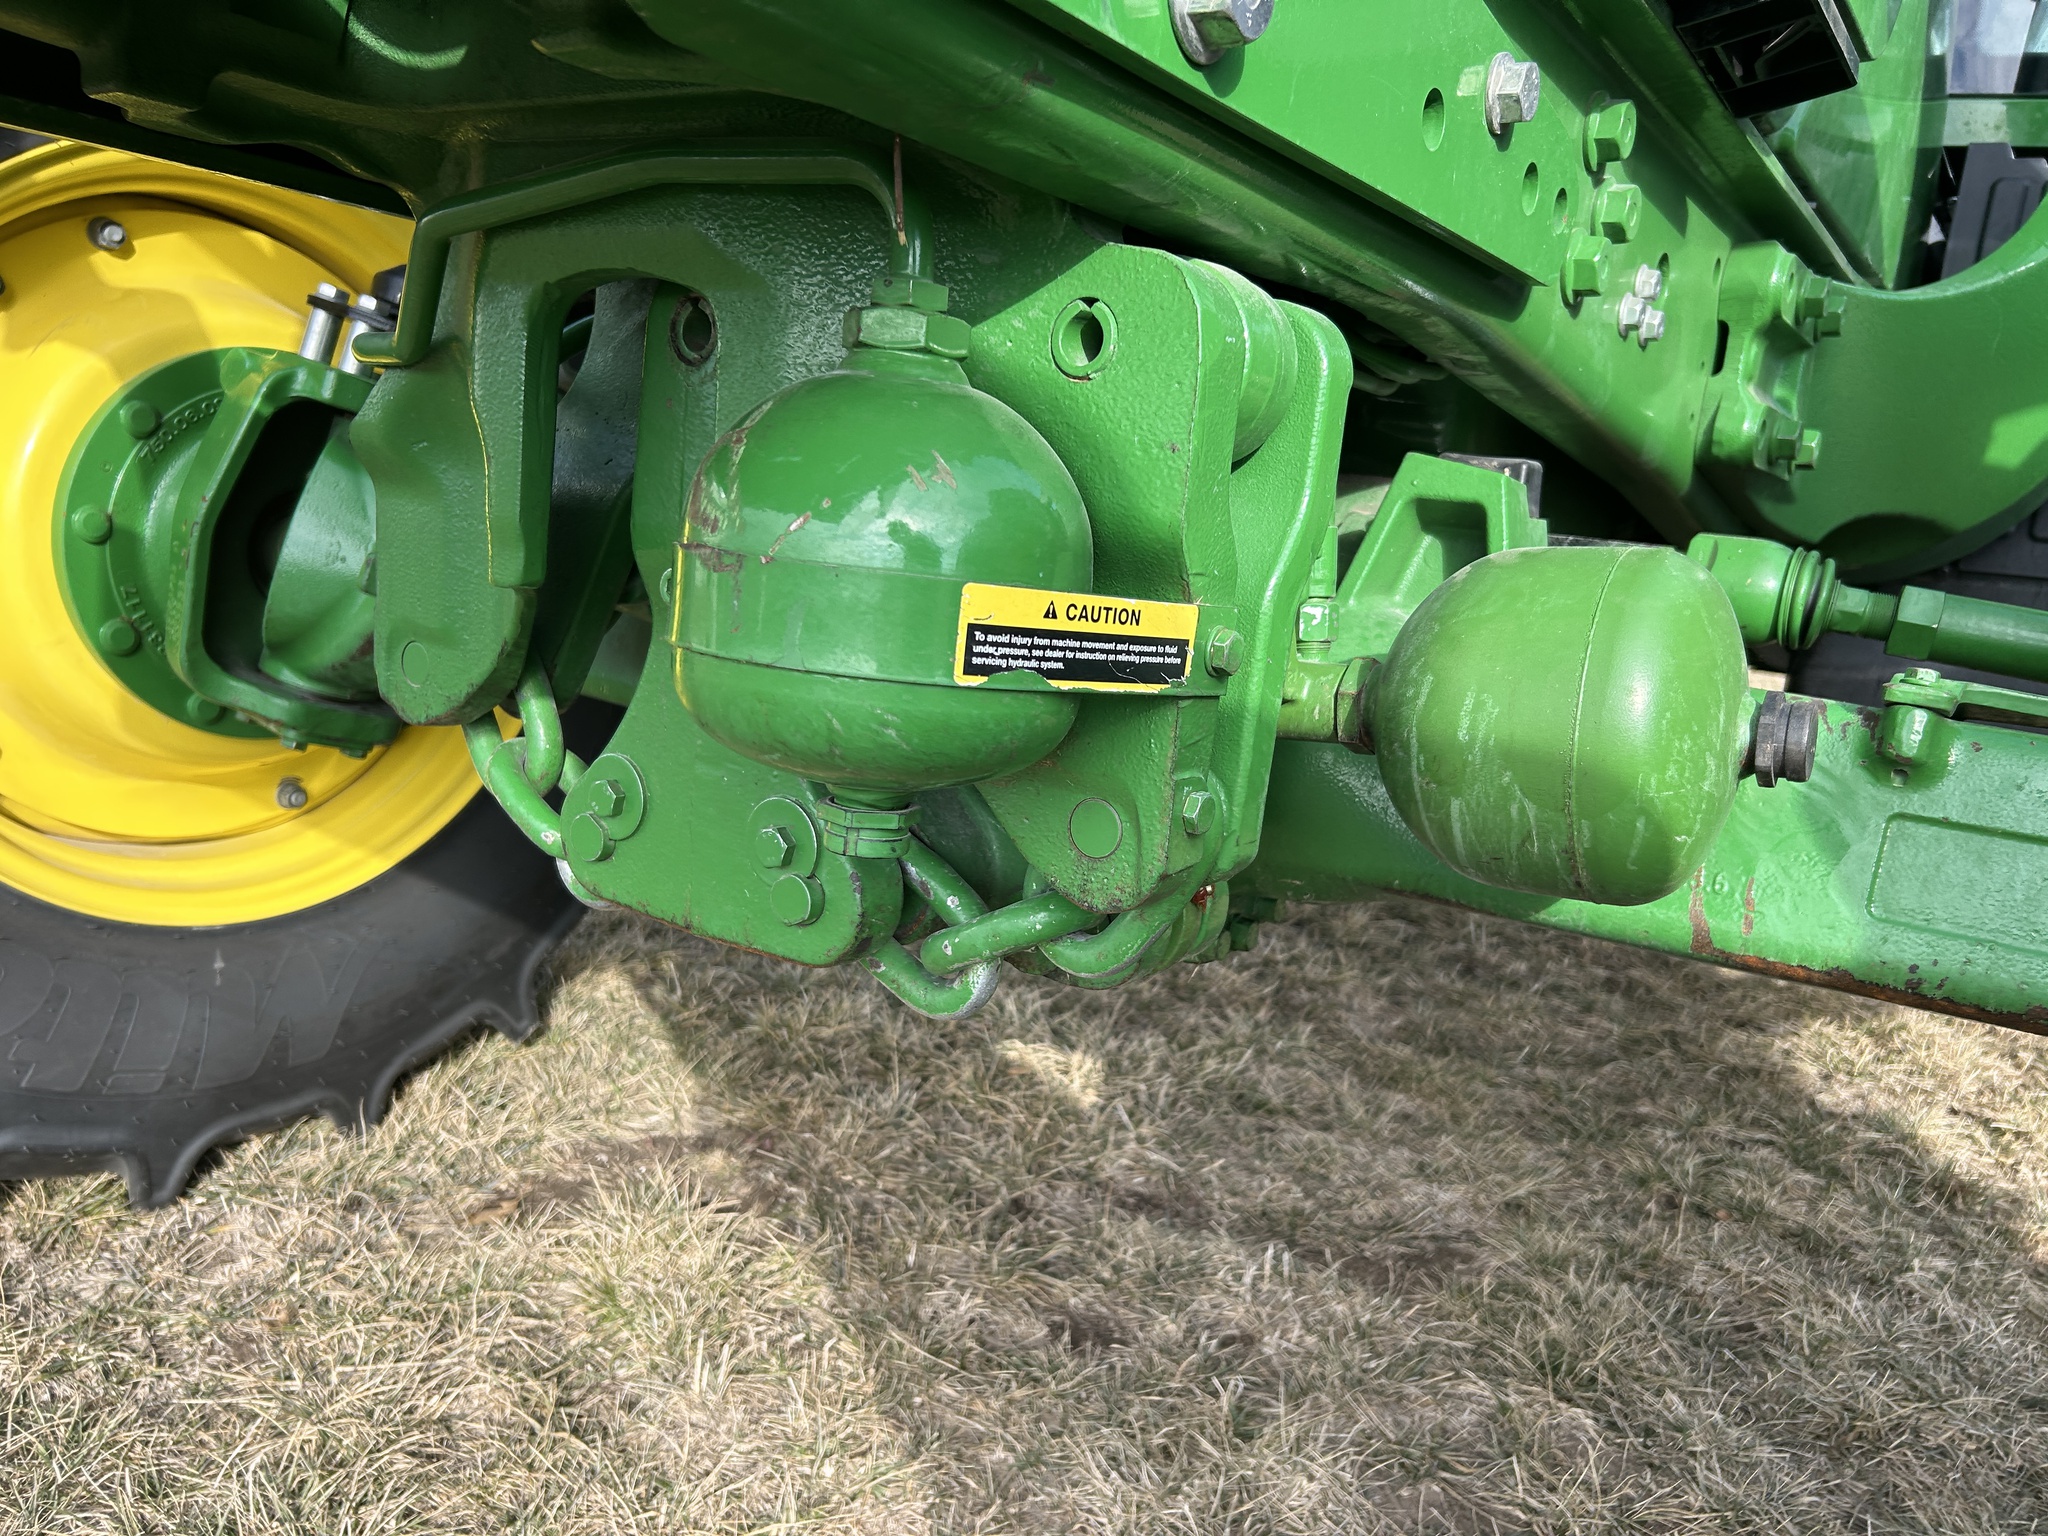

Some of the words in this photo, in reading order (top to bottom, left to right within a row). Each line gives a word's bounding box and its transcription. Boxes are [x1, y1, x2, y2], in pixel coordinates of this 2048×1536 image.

[1066, 603, 1141, 626] CAUTION
[974, 631, 985, 642] To
[986, 633, 1010, 643] avoid
[1011, 634, 1032, 646] injury
[1033, 636, 1051, 646] from
[1051, 638, 1081, 648] machine
[1081, 640, 1116, 650] movement
[1116, 642, 1129, 651] and
[1129, 643, 1157, 653] exposure
[1157, 645, 1164, 653] to
[1164, 645, 1178, 654] fluid
[971, 656, 1008, 668] servicing
[1008, 658, 1040, 669] hydraulic
[1040, 661, 1065, 670] system.
[972, 644, 996, 655] under
[997, 648, 1031, 657] pressure,
[1044, 648, 1065, 658] dealer
[1065, 650, 1075, 659] for
[1076, 650, 1107, 660] instruction
[1107, 653, 1116, 661] on
[1116, 653, 1140, 664] relieving
[1140, 655, 1164, 664] pressure
[1164, 656, 1182, 664] before
